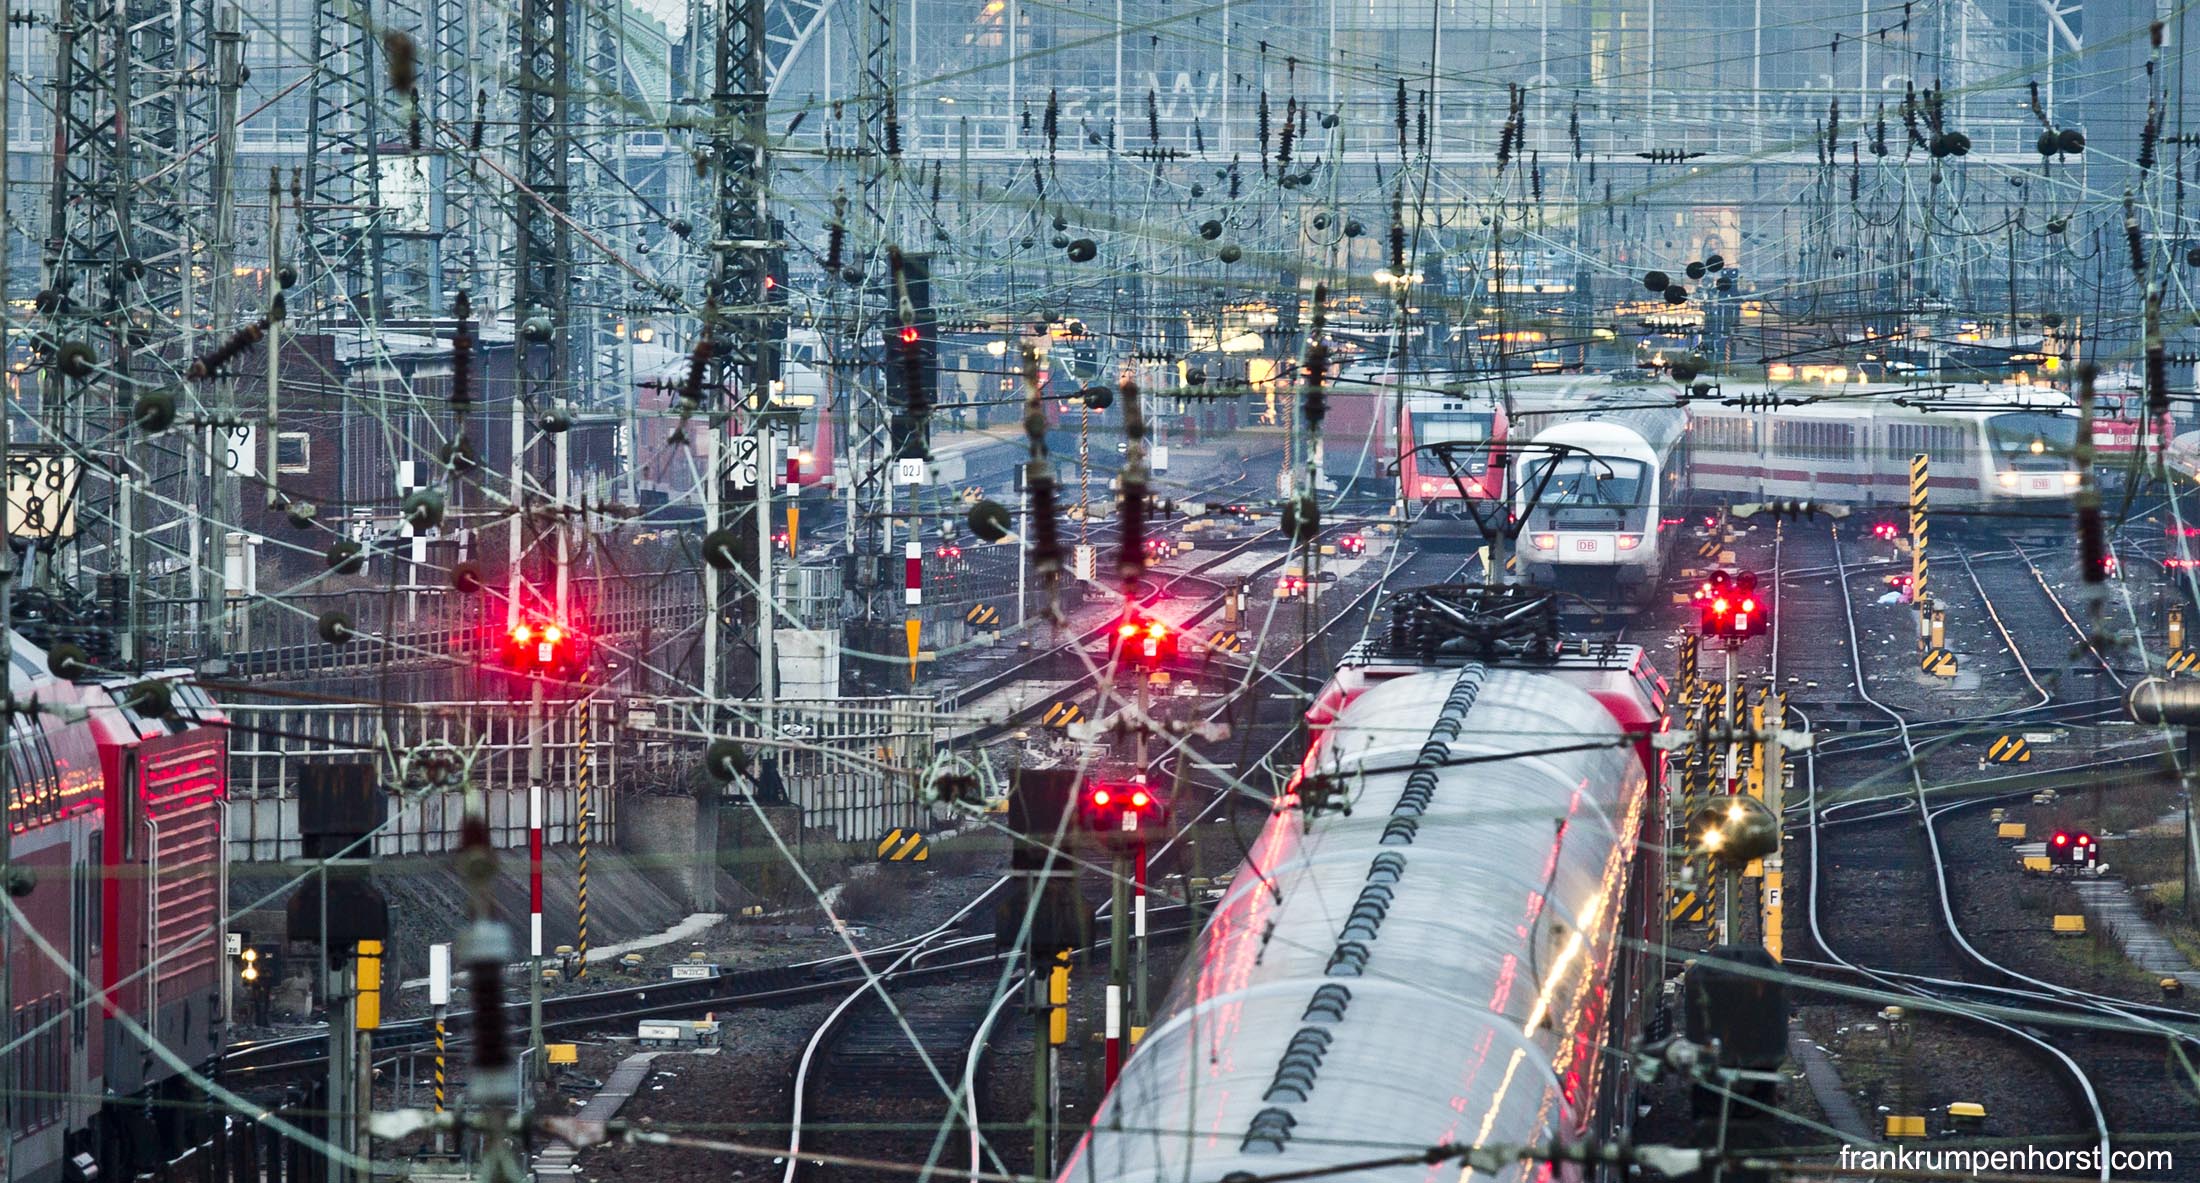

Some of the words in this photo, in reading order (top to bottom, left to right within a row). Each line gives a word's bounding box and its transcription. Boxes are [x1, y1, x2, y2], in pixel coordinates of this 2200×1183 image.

[25, 496, 44, 530] 8
[1579, 540, 1596, 551] DB
[1770, 890, 1779, 904] F
